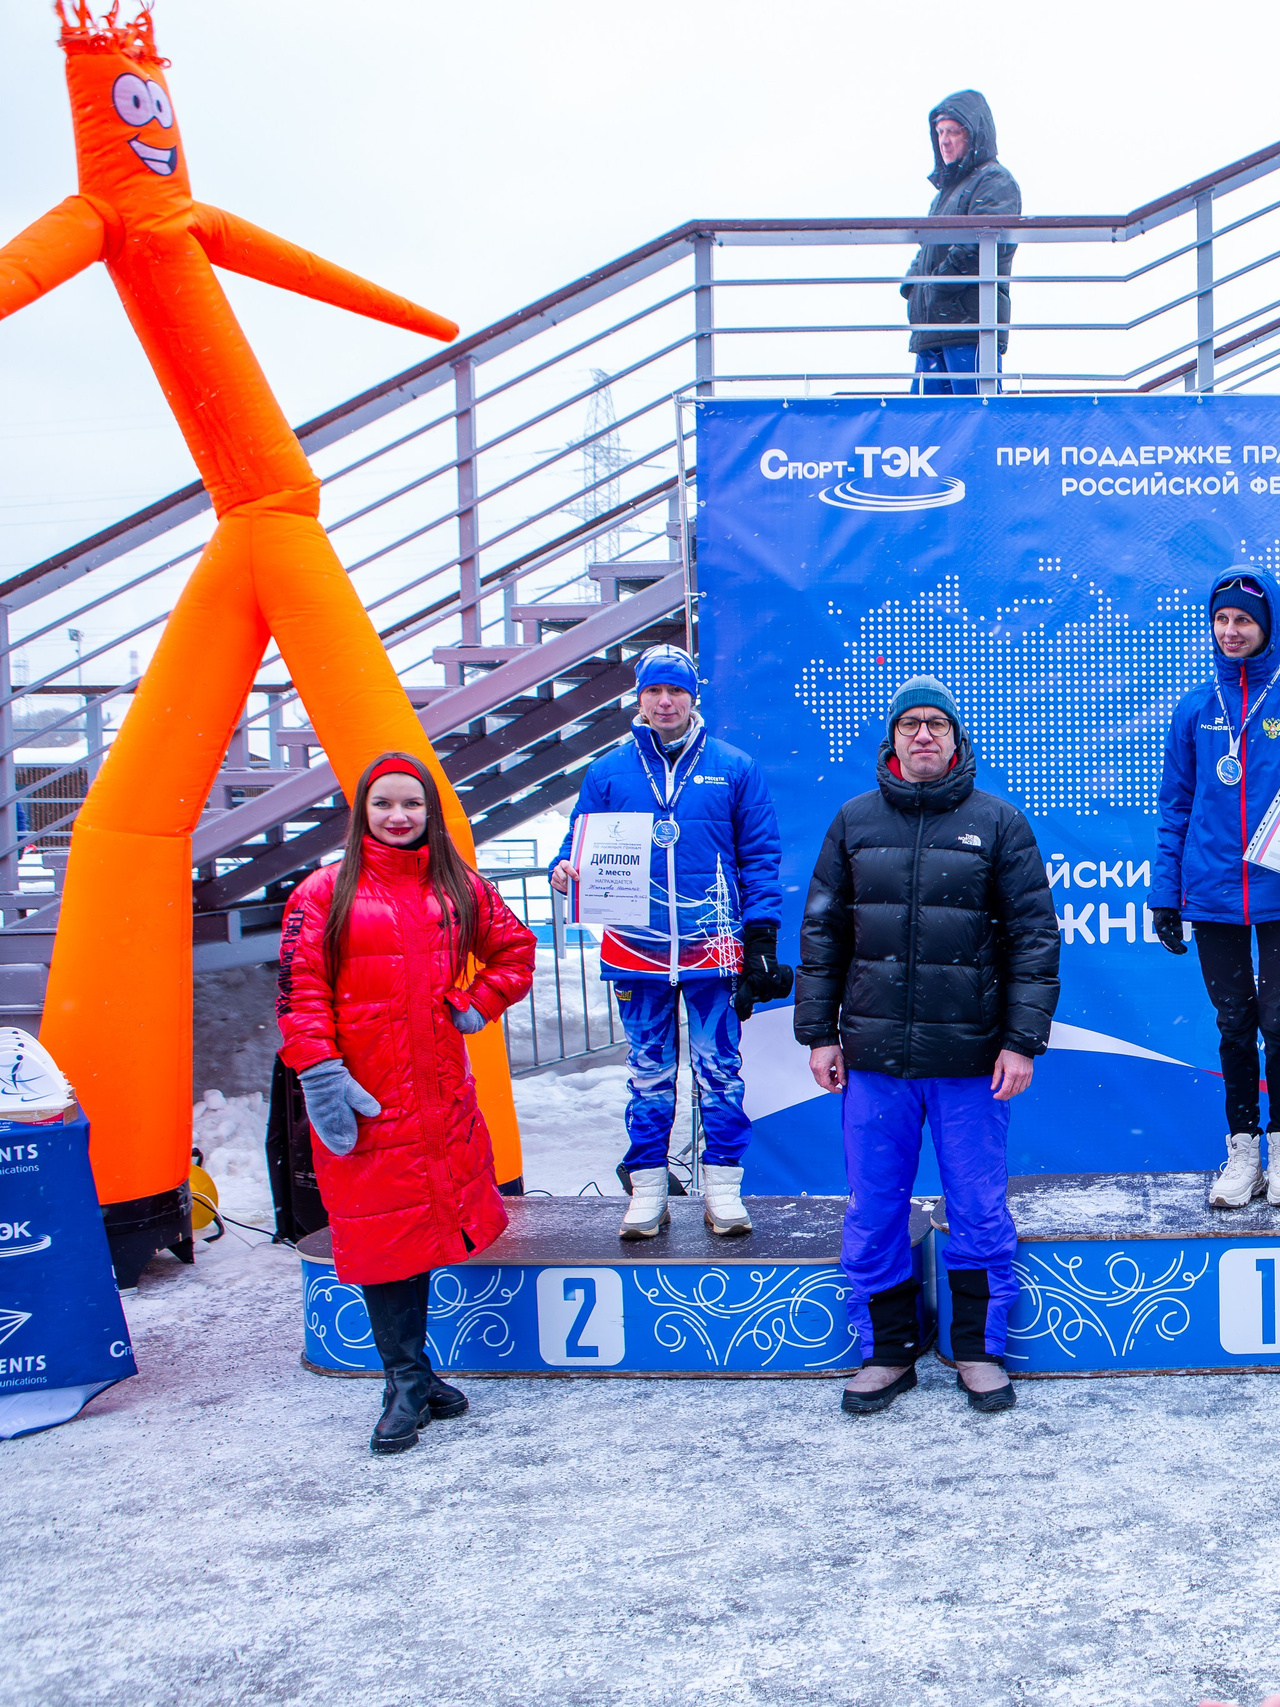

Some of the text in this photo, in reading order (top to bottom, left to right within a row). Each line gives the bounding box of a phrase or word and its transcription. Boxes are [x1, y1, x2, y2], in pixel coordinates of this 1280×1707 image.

[996, 447, 1050, 466] ПРИ
[1061, 445, 1232, 467] ПОДДЕРЖКЕ
[1061, 471, 1239, 497] РОССИЙСКОЙ
[591, 853, 640, 866] ДИПЛОМ
[598, 868, 604, 876] 2
[1046, 853, 1150, 888] ЙСКИ
[0, 1143, 39, 1162] NTS
[0, 1221, 32, 1241] ЭК
[1255, 1258, 1276, 1344] 1
[563, 1277, 599, 1357] 2
[0, 1355, 47, 1374] ENTS
[0, 1376, 47, 1388] unications
